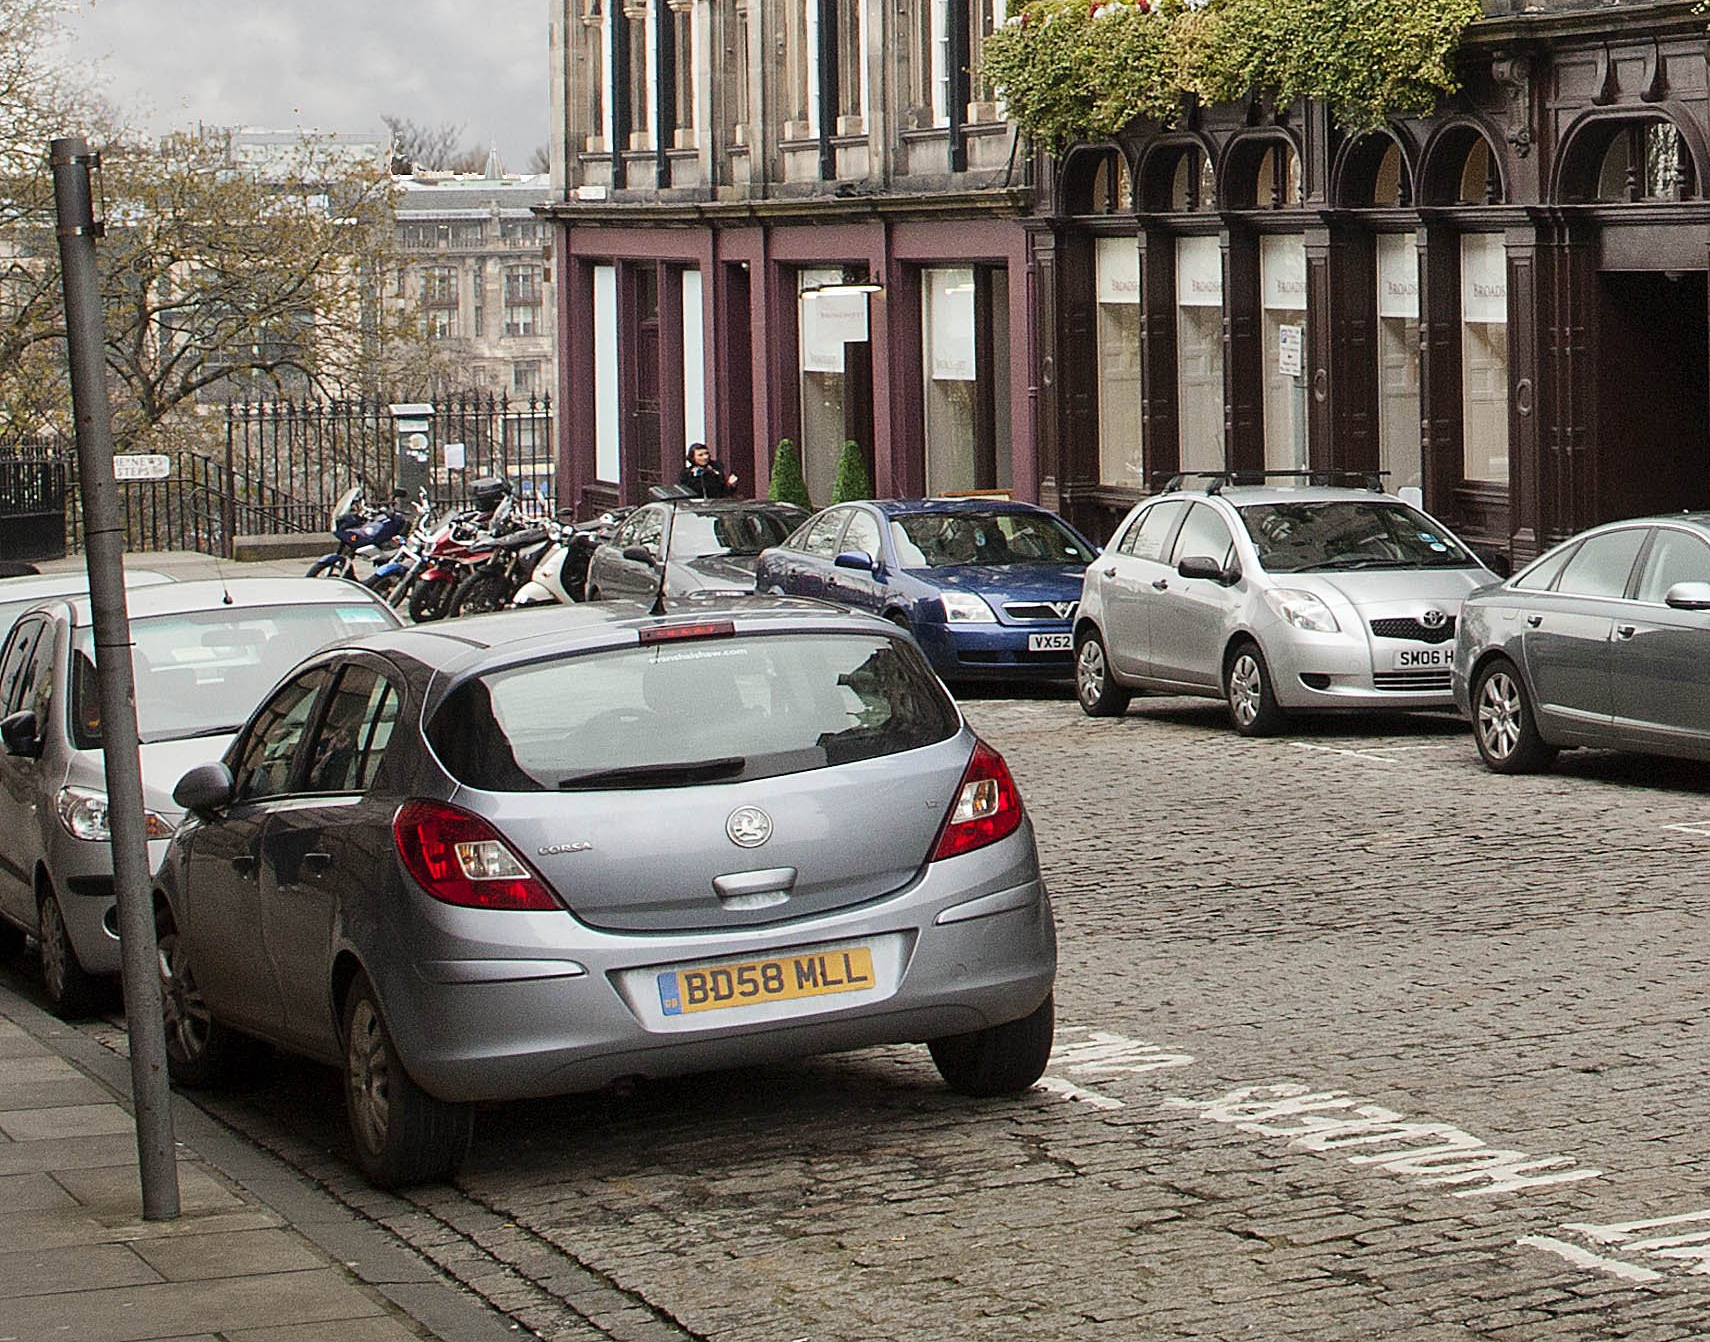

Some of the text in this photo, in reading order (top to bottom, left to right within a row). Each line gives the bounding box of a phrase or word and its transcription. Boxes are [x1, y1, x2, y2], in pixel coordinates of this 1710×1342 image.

[1400, 649, 1441, 666] SM06
[685, 953, 868, 1005] BD58 MLL
[1048, 1025, 1195, 1074] ONL
[1162, 1084, 1603, 1198] HOLDERS
